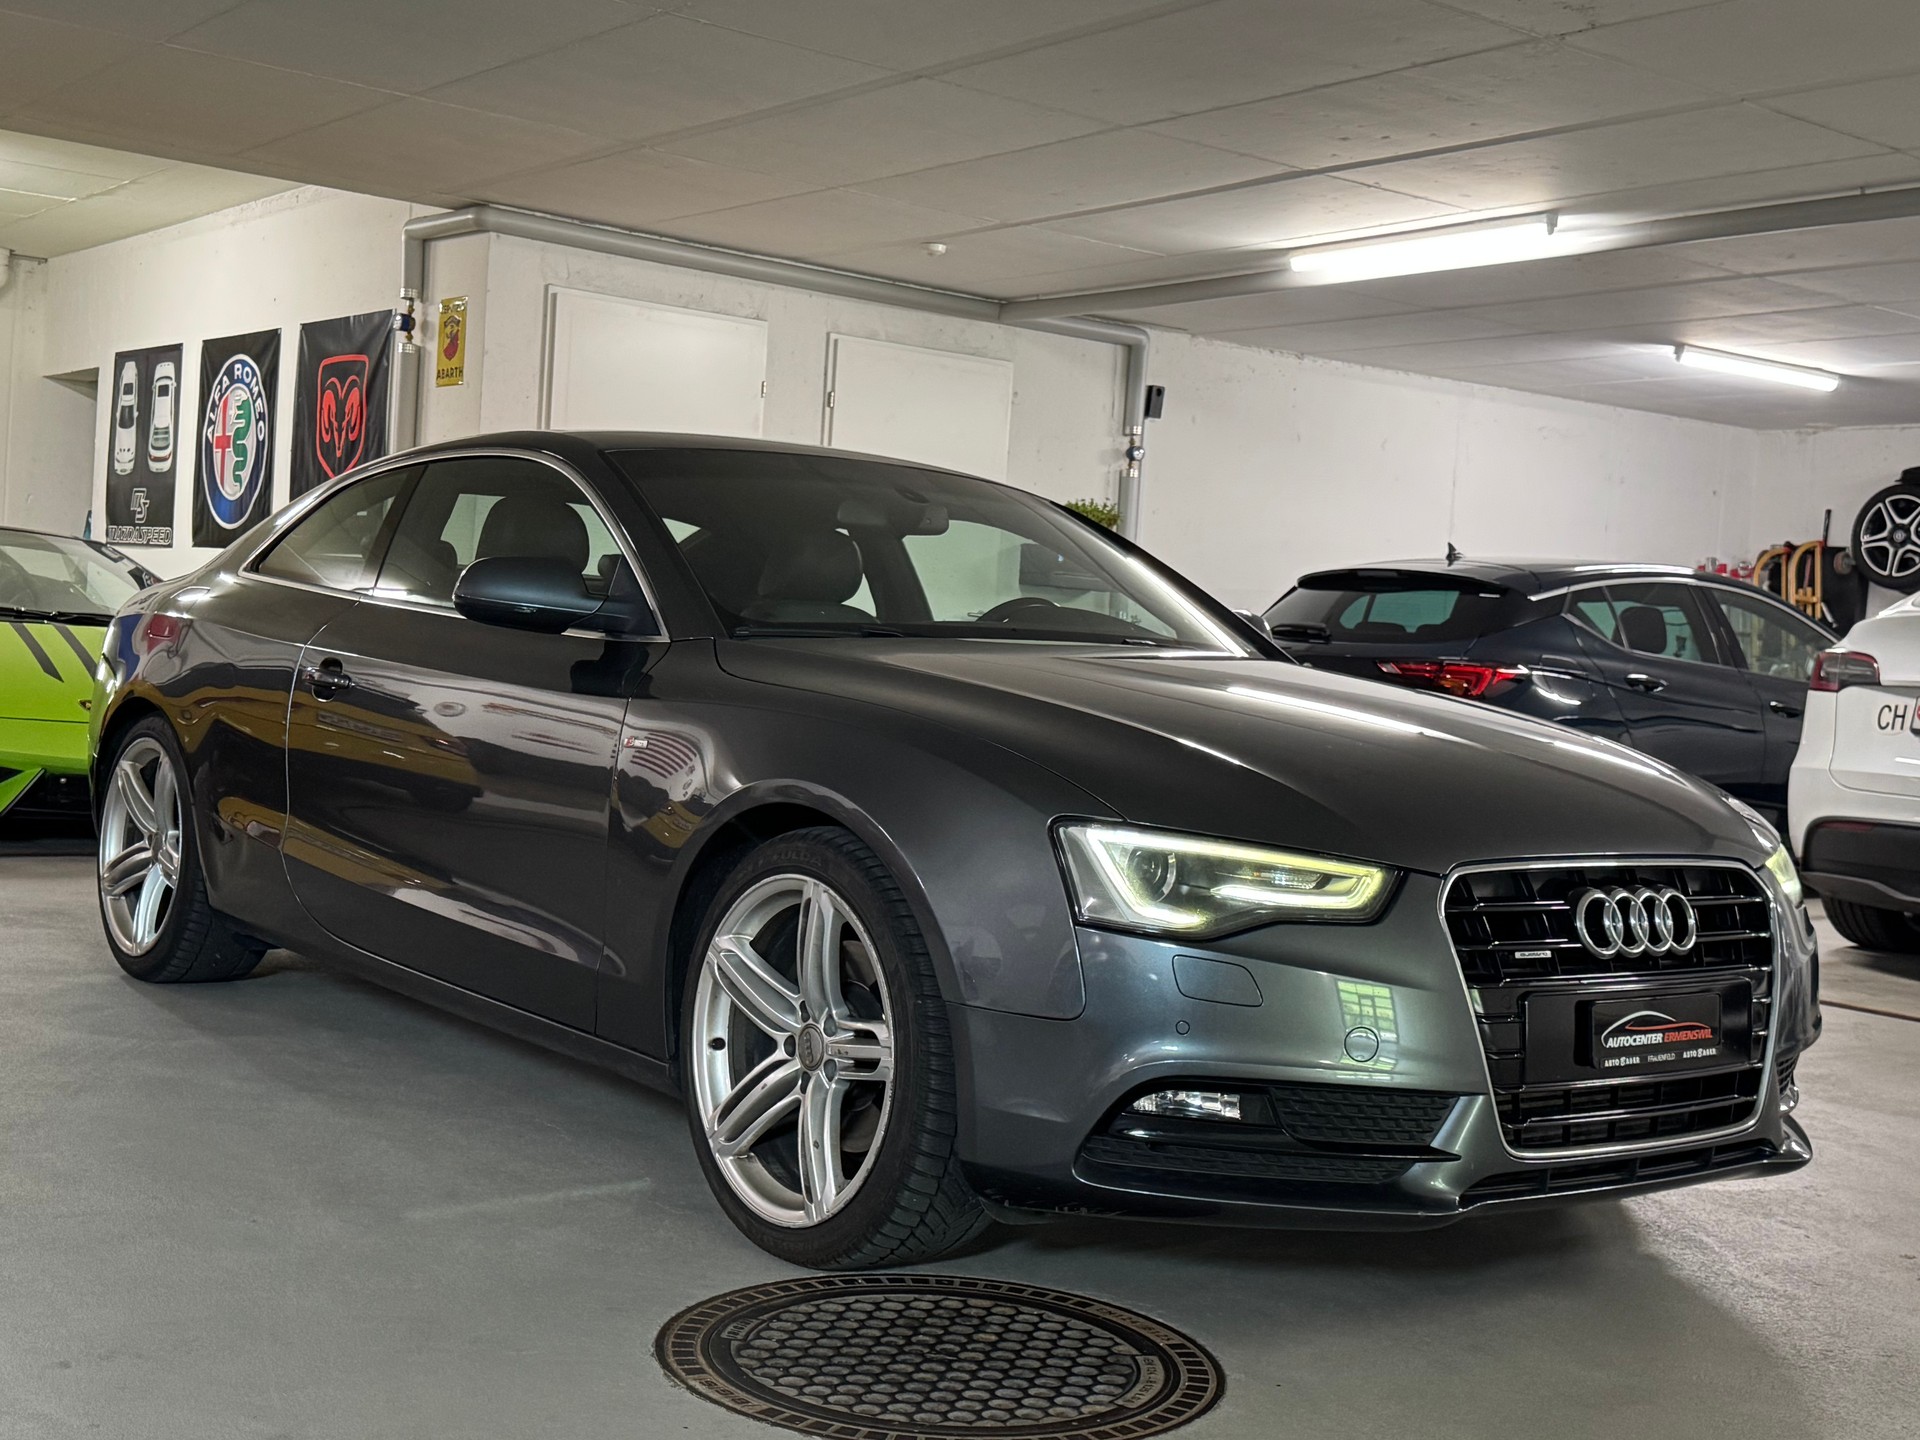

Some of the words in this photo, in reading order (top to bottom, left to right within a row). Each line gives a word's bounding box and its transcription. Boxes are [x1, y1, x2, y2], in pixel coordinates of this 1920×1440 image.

[437, 367, 463, 380] ABARTH
[206, 374, 231, 444] ALFA
[234, 363, 265, 442] ROMEO
[108, 525, 172, 545] MAZDASPEED
[1877, 704, 1908, 731] CH
[1606, 1032, 1664, 1048] AUTOCENTER
[1664, 1028, 1713, 1043] ERMENSWIL
